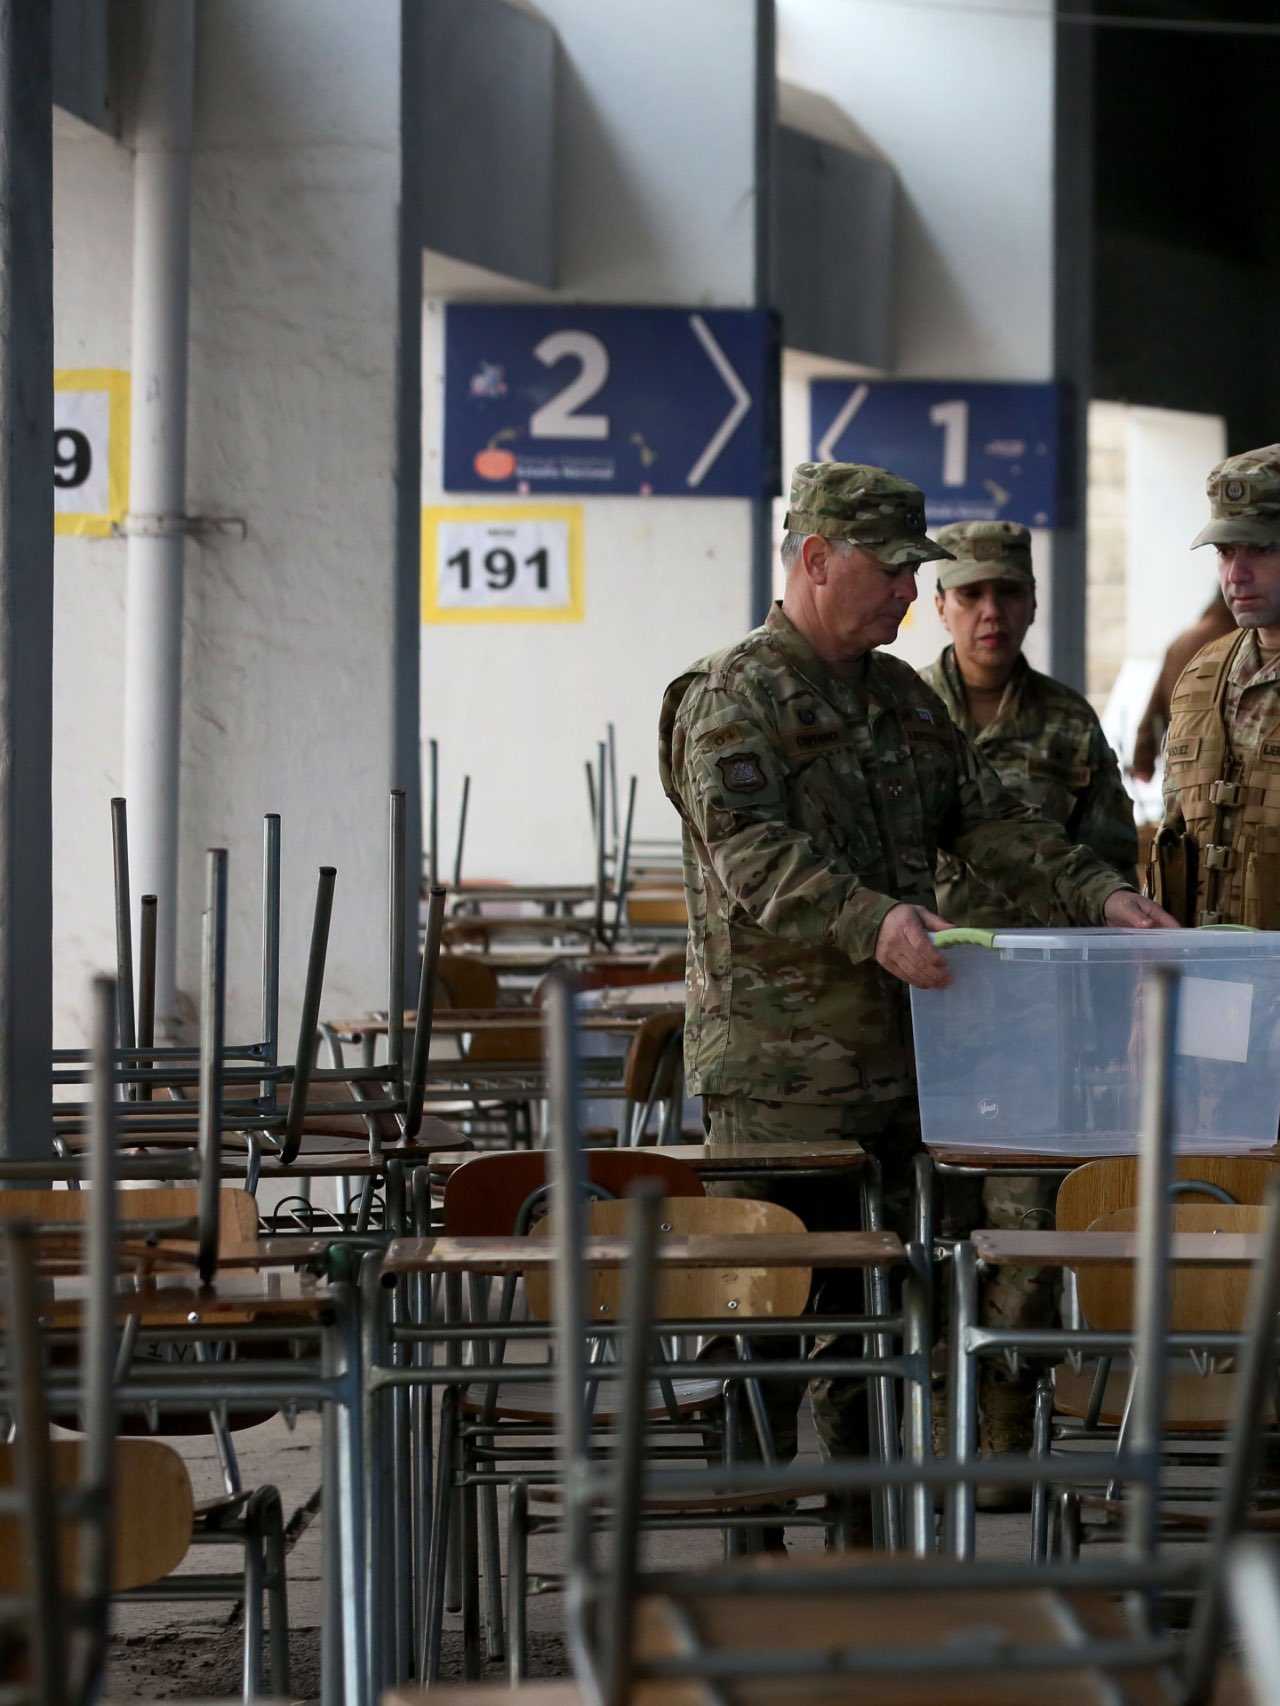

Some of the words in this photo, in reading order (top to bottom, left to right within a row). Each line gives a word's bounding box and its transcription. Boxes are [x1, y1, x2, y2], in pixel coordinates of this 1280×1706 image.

[530, 329, 609, 440] 2
[930, 400, 968, 486] 1
[447, 547, 549, 590] 191
